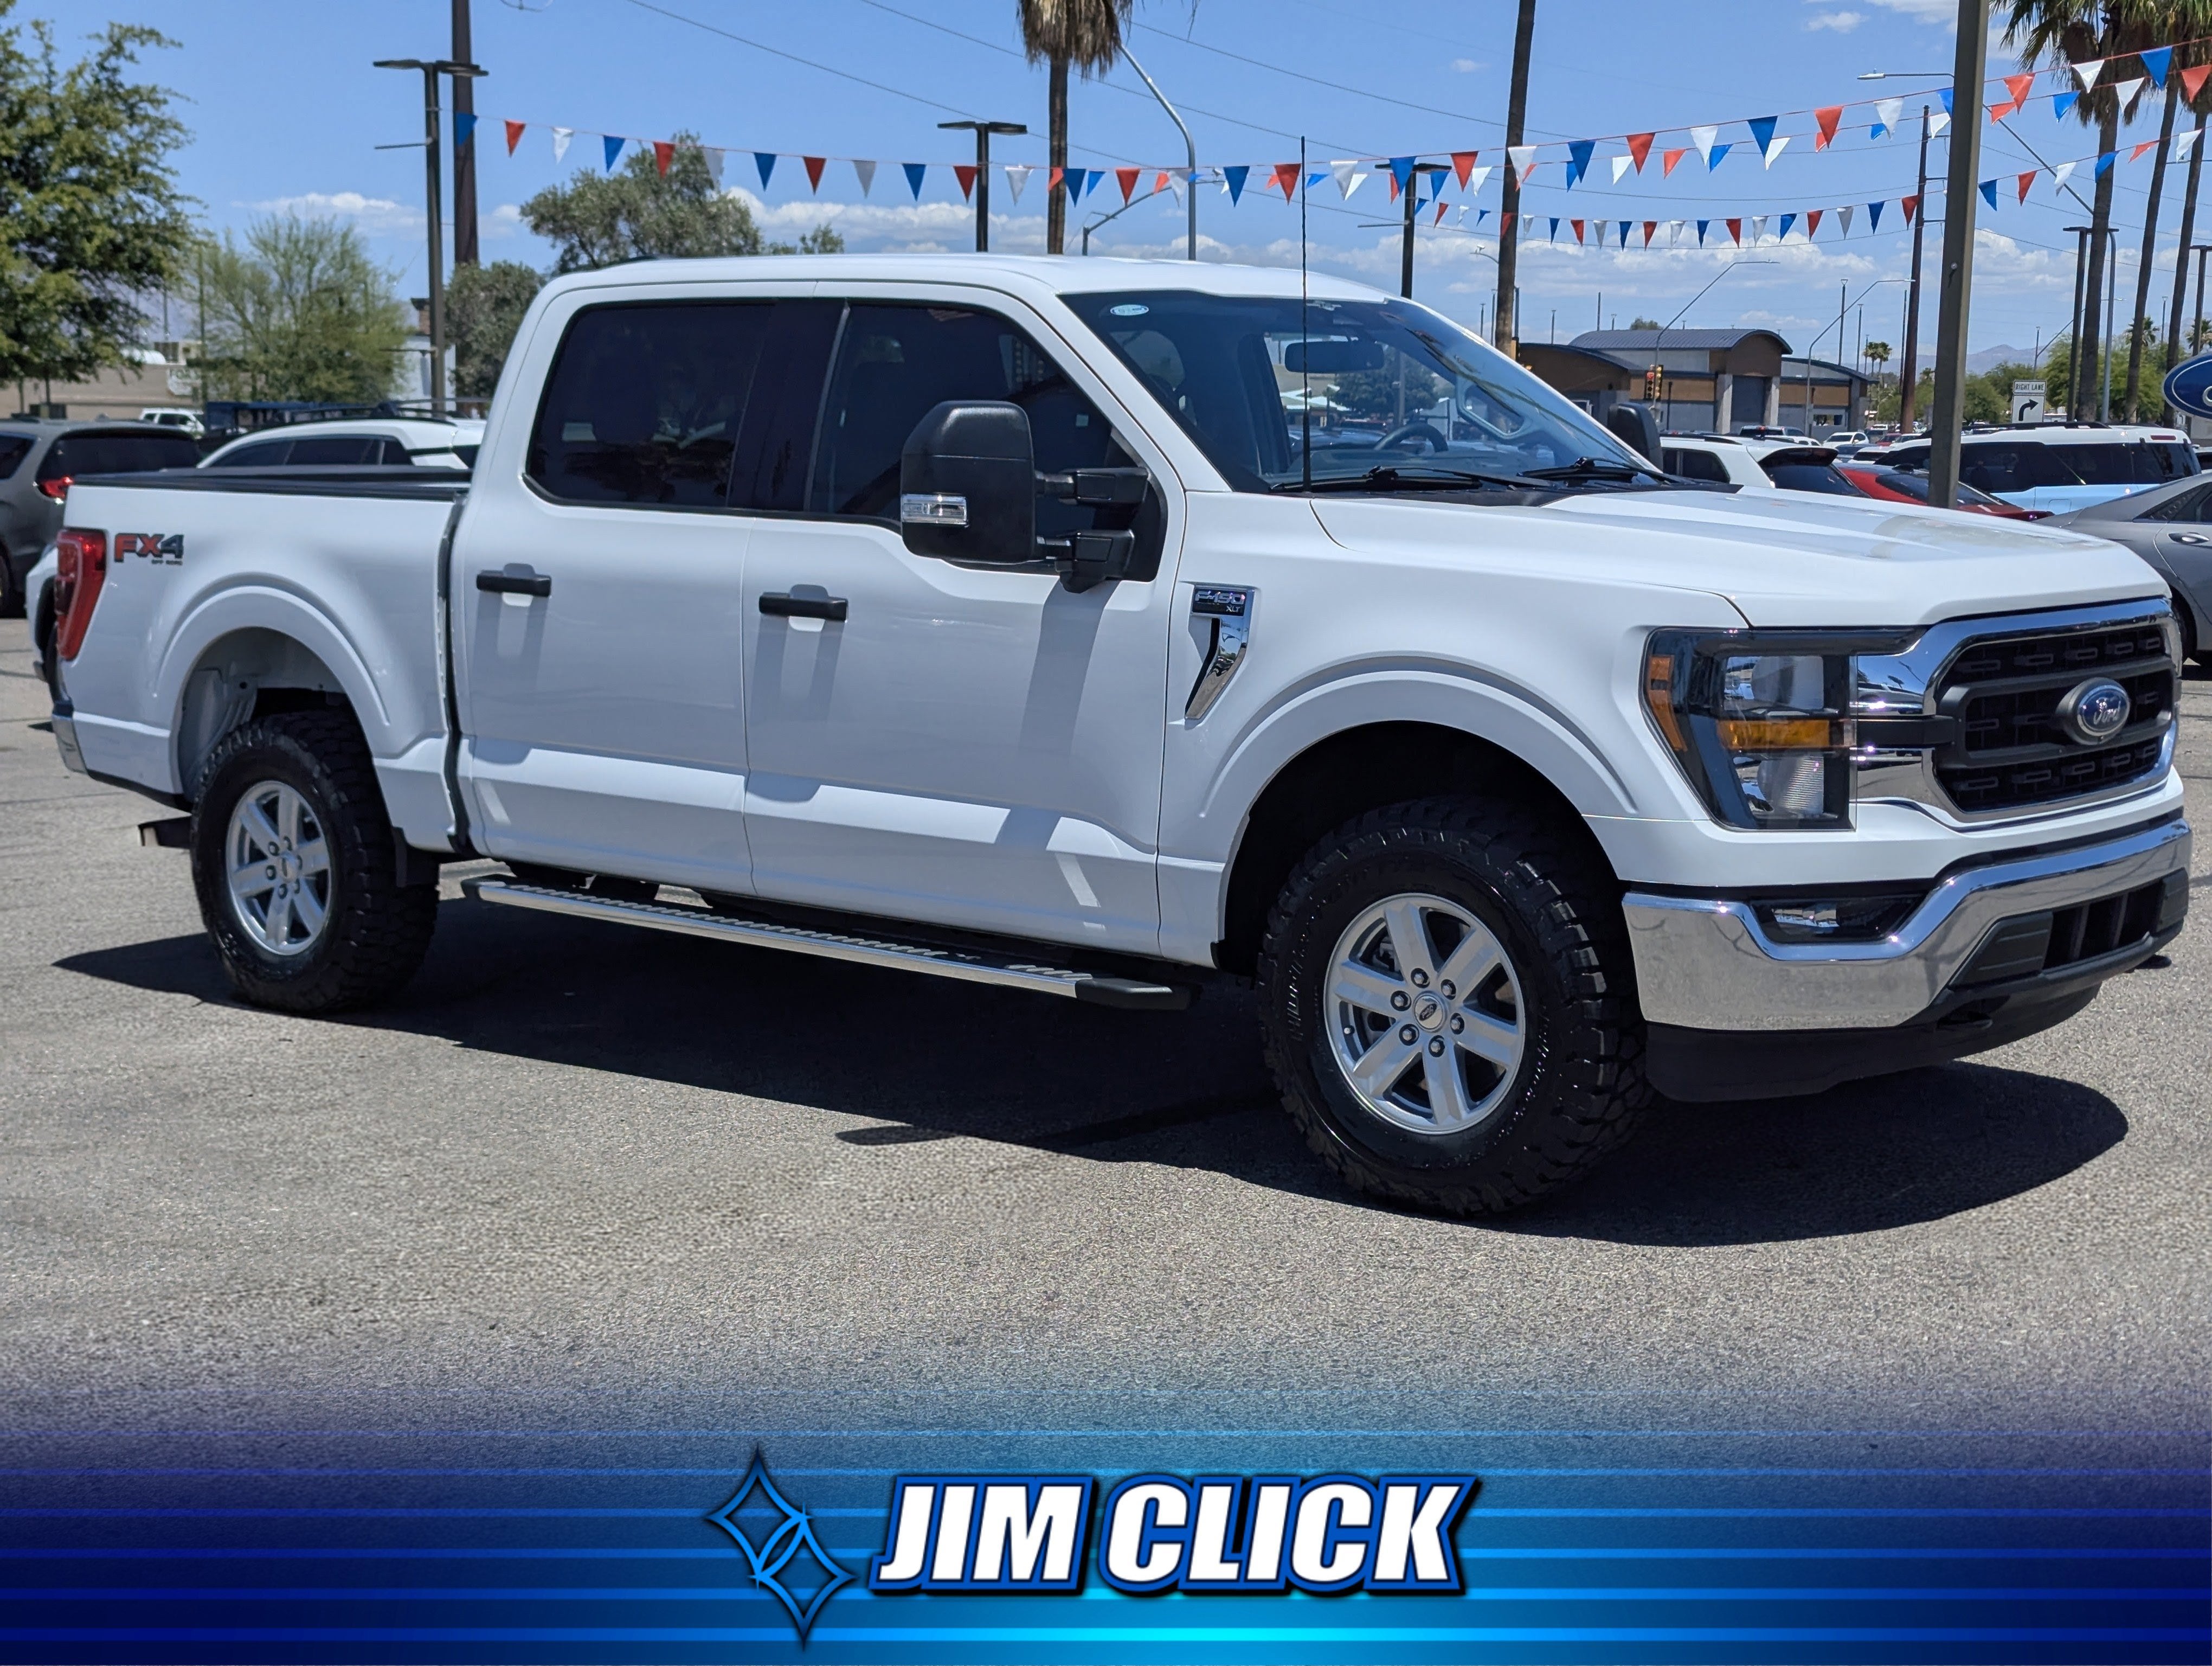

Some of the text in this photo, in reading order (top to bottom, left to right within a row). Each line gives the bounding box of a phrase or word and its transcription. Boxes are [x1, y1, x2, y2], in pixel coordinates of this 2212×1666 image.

[114, 533, 184, 562] FX4
[1194, 590, 1245, 605] F-150
[2093, 696, 2121, 725] Ford
